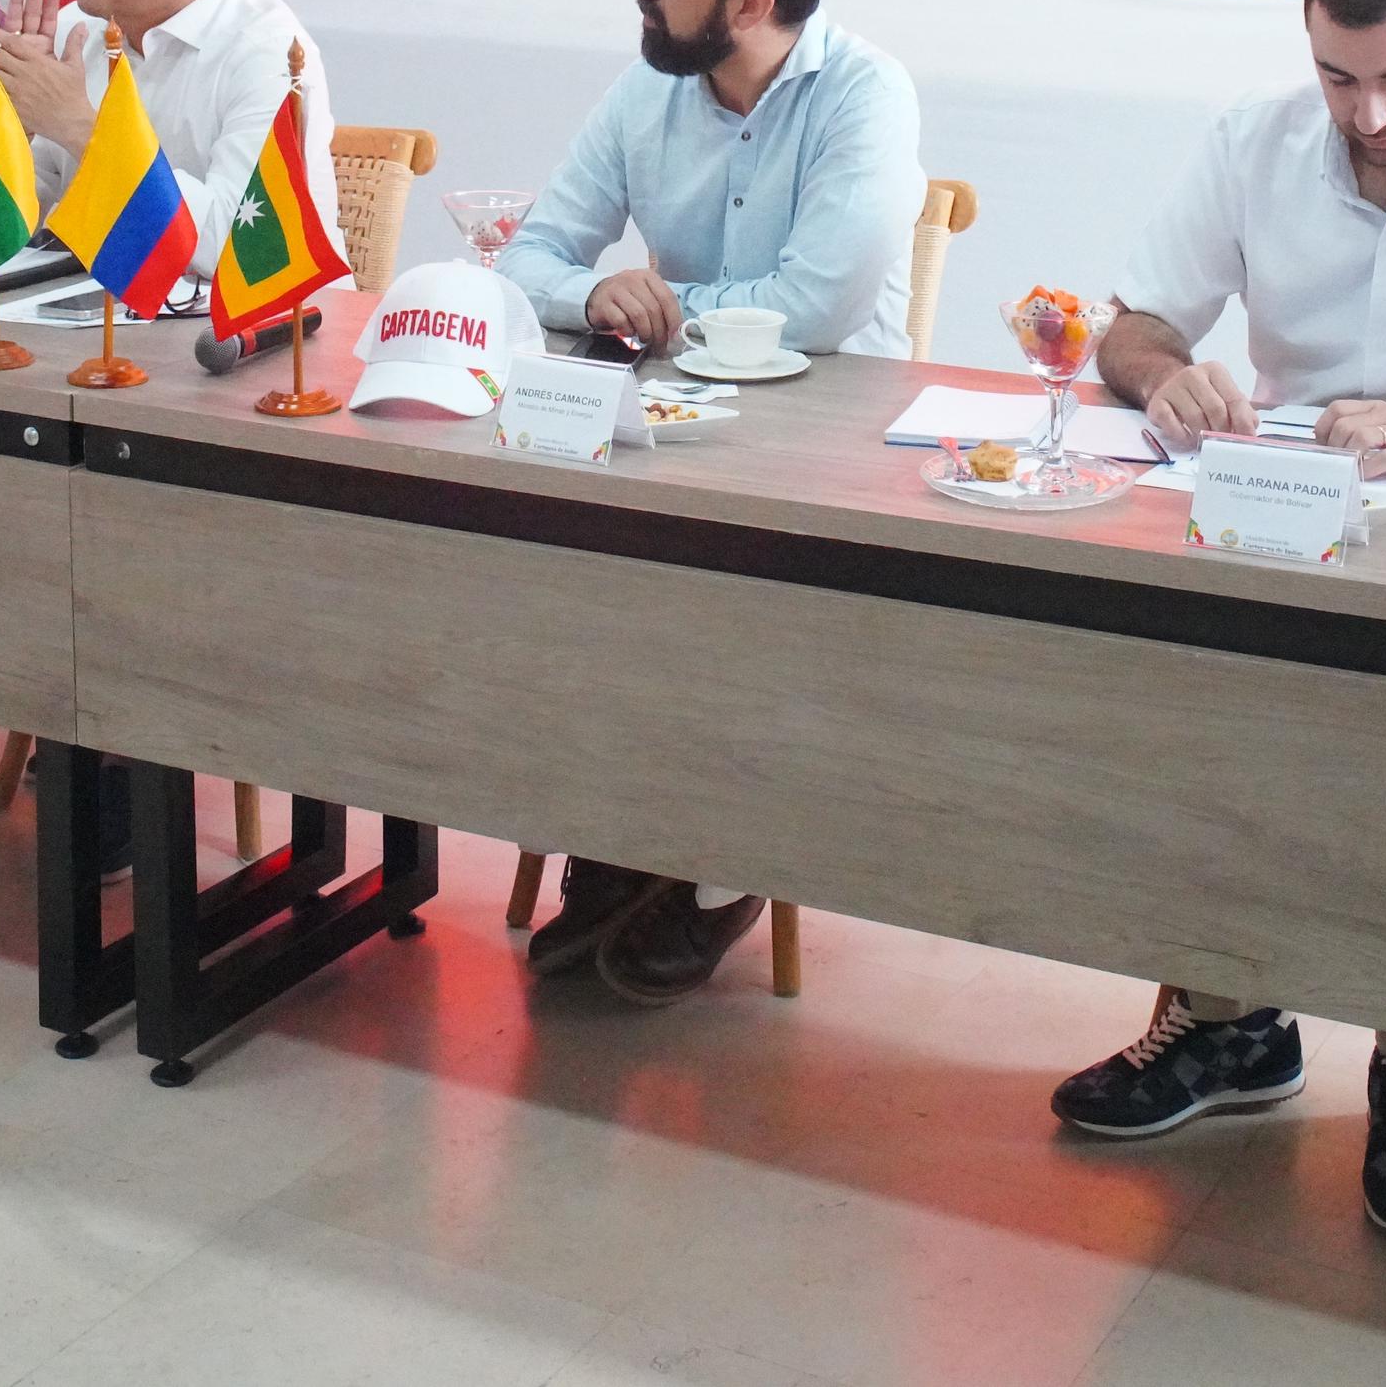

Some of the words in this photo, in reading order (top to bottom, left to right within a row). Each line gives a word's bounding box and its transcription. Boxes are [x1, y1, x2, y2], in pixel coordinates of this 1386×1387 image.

[380, 309, 487, 350] CARTAGENA
[554, 393, 603, 408] CAMACHO
[1207, 470, 1244, 486] YAMIL
[1246, 476, 1290, 492] ARANA
[1293, 483, 1341, 499] PADAUI
